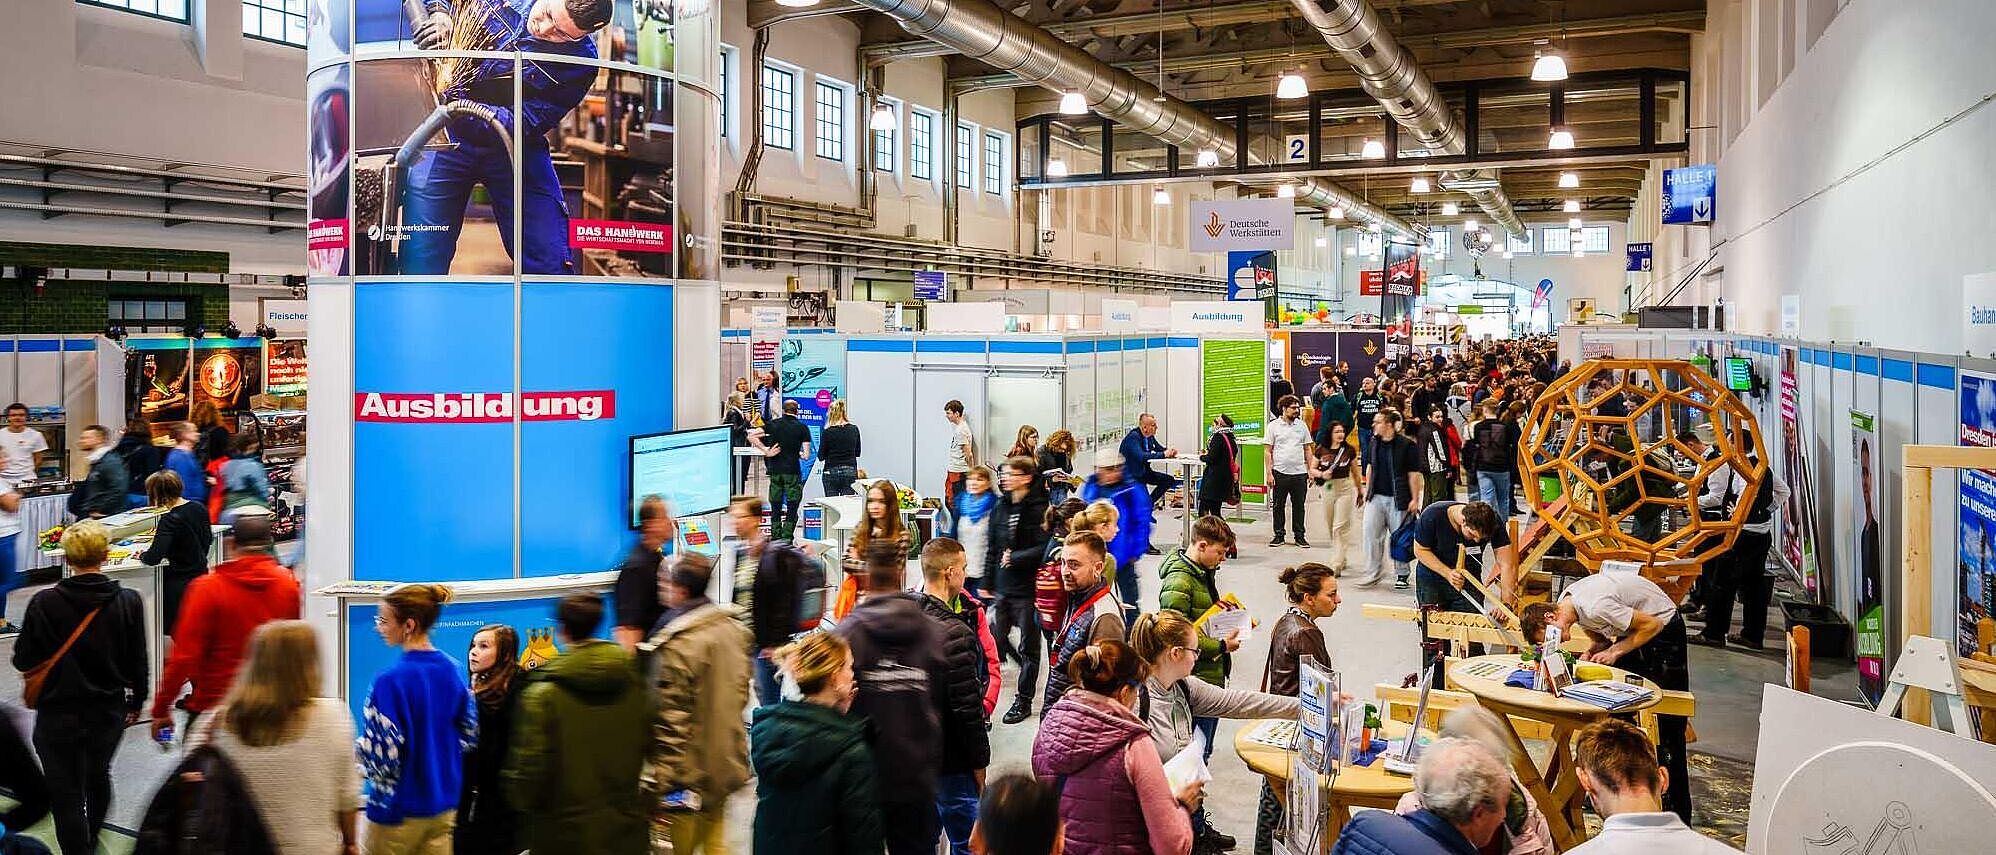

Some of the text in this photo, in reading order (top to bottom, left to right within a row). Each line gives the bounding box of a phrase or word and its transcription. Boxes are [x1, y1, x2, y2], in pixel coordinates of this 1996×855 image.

[1290, 139, 1305, 159] 2
[1666, 170, 1704, 186] HALLE
[385, 224, 449, 232] Handwerkskammer
[1229, 219, 1270, 228] Deutsche
[576, 225, 664, 240] DAS HANDWERK
[1229, 228, 1281, 237] Werkstätten
[1628, 244, 1647, 252] HALLE
[1192, 312, 1243, 322] Ausbildung
[269, 358, 286, 366] Die
[360, 392, 603, 421] Ausbildung
[1961, 423, 1991, 448] Dresden
[1961, 467, 1974, 486] Wir
[1961, 494, 1970, 508] zu
